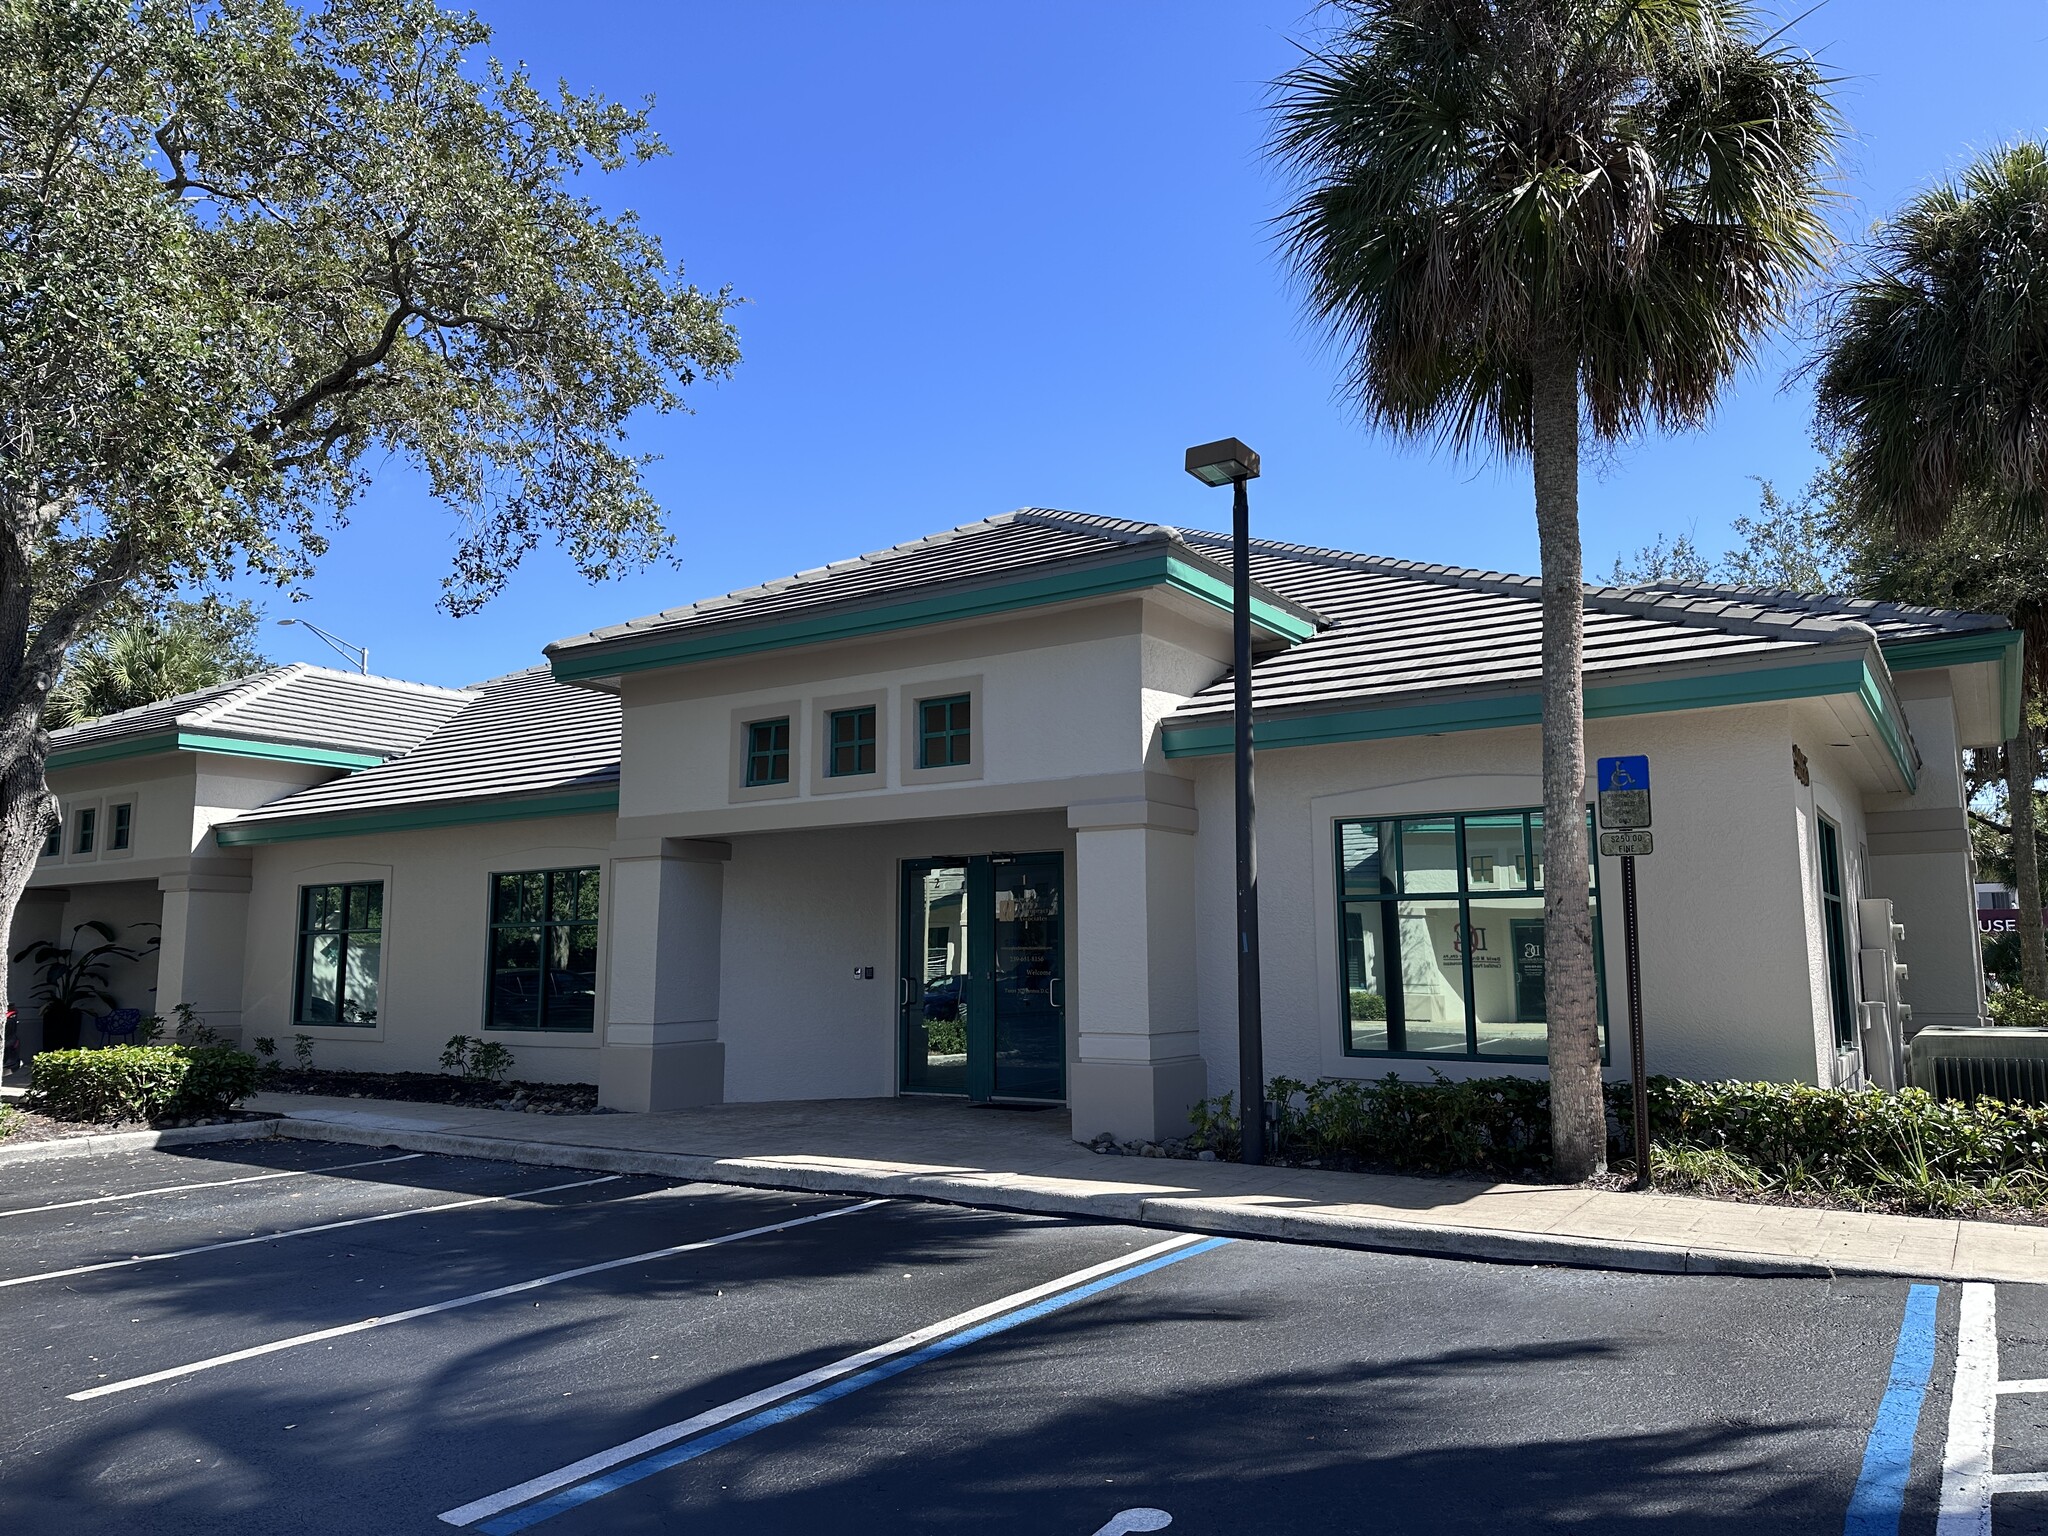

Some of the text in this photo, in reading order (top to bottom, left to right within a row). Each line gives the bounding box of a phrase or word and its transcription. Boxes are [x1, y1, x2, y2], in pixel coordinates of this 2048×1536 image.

[1618, 844, 1635, 853] FINE
[934, 878, 940, 888] 2
[1978, 919, 2016, 932] USE
[1026, 968, 1052, 976] Welcome
